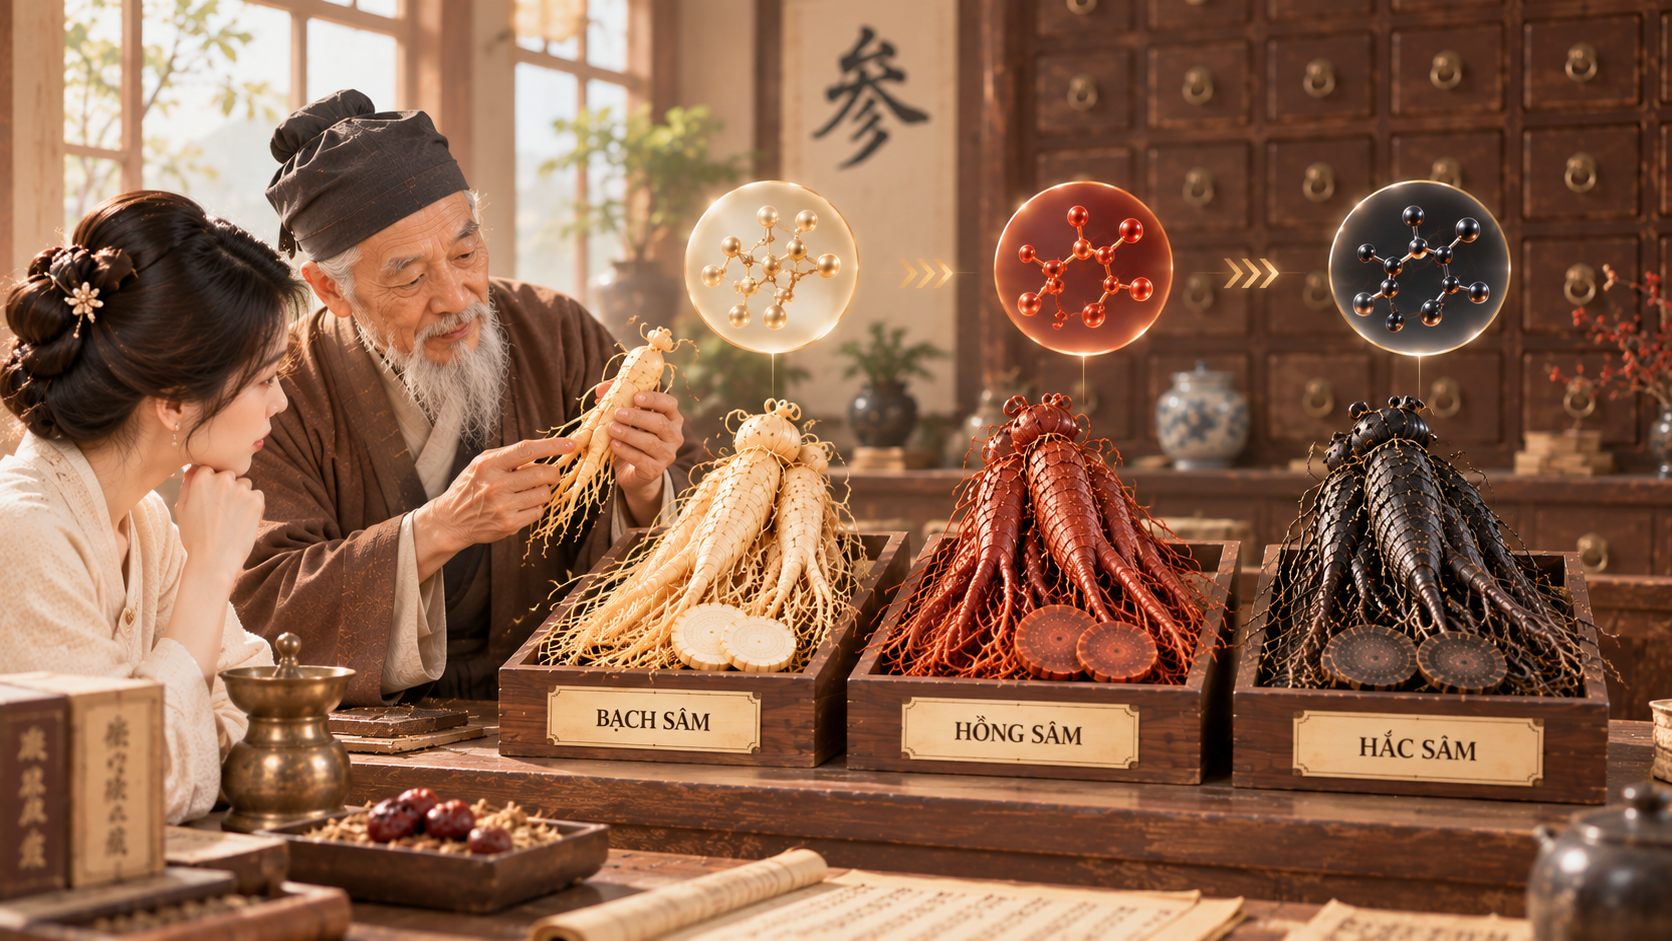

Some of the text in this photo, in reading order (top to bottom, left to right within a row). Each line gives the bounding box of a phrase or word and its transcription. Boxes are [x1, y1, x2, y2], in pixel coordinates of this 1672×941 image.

[811, 24, 931, 170] 参
[596, 707, 711, 732] BẠCH SÂM
[954, 715, 1083, 745] HỒNG SÂM
[1359, 729, 1477, 761] HẮC SÂM
